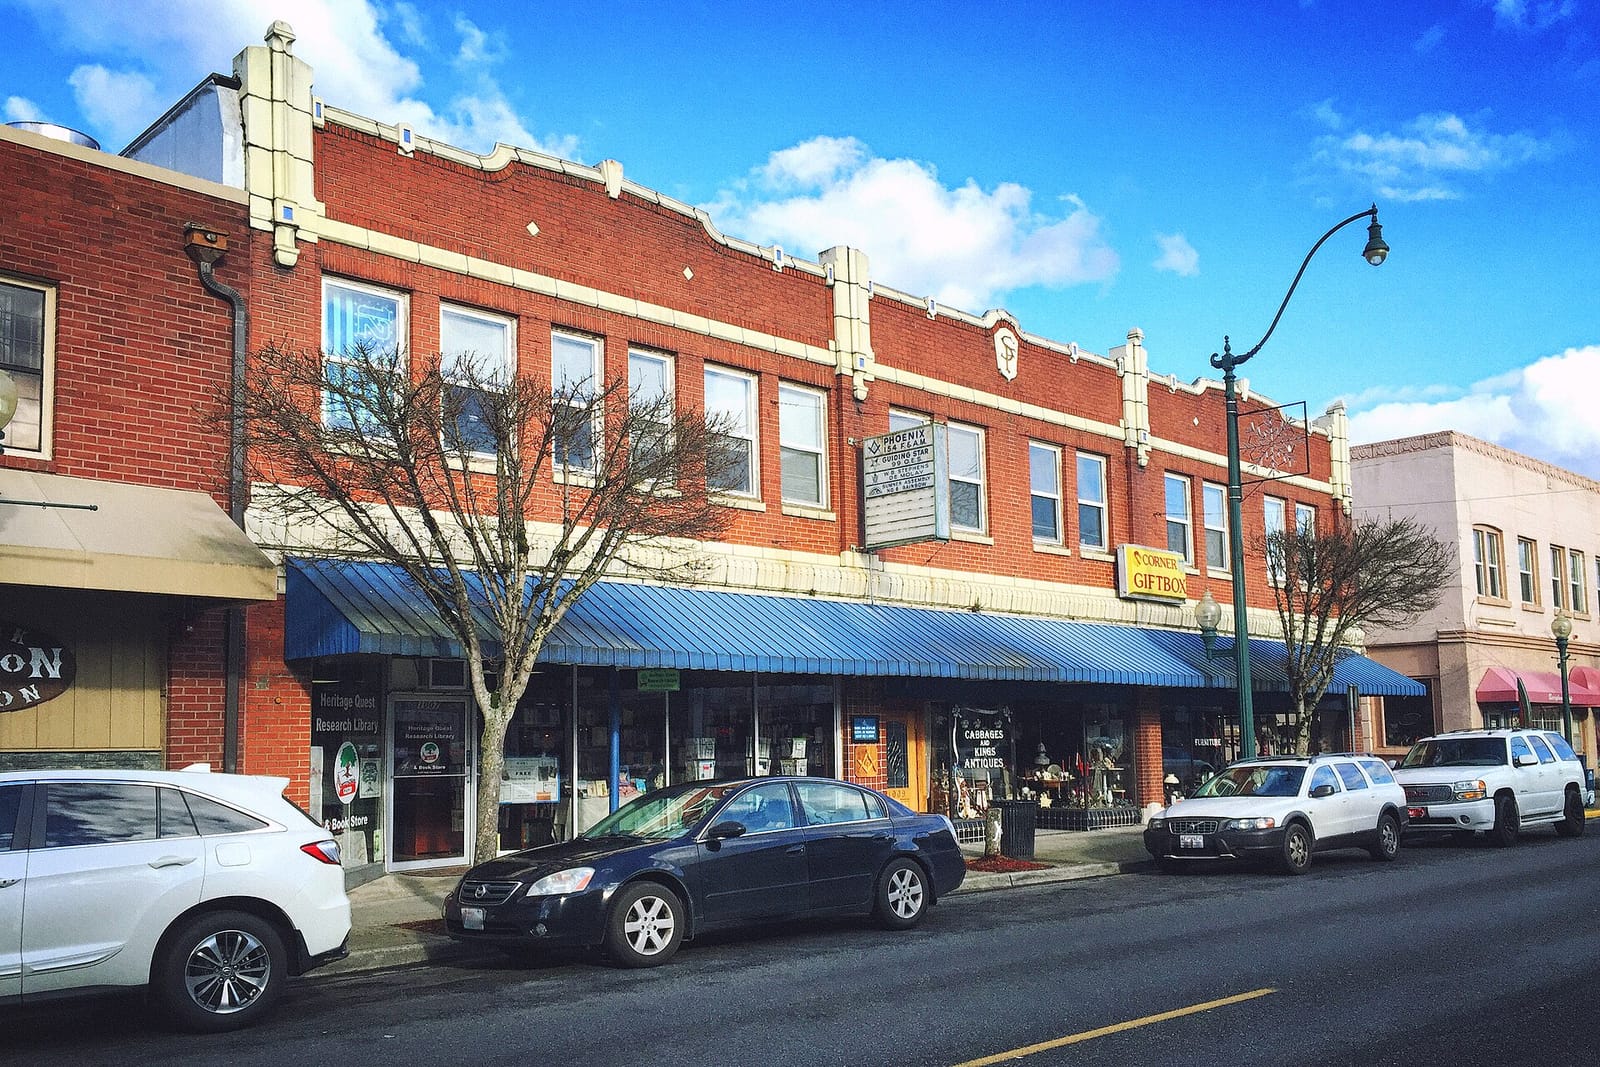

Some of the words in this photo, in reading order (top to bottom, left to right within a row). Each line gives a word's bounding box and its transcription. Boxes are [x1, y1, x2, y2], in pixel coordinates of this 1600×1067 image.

[883, 429, 925, 445] PHOENIX
[881, 451, 911, 463] GUIDING
[912, 448, 929, 457] STAR
[1142, 553, 1178, 570] CORNER
[1133, 572, 1187, 594] GIFTBOX
[320, 693, 353, 711] Heritage
[354, 694, 375, 708] Quest
[316, 717, 352, 732] Research
[353, 718, 378, 734] Library
[964, 730, 1004, 740] CABBAGES
[974, 747, 996, 757] KINGS
[964, 758, 1004, 769] ANTIQUES
[331, 817, 350, 830] Book
[350, 815, 368, 828] Store
